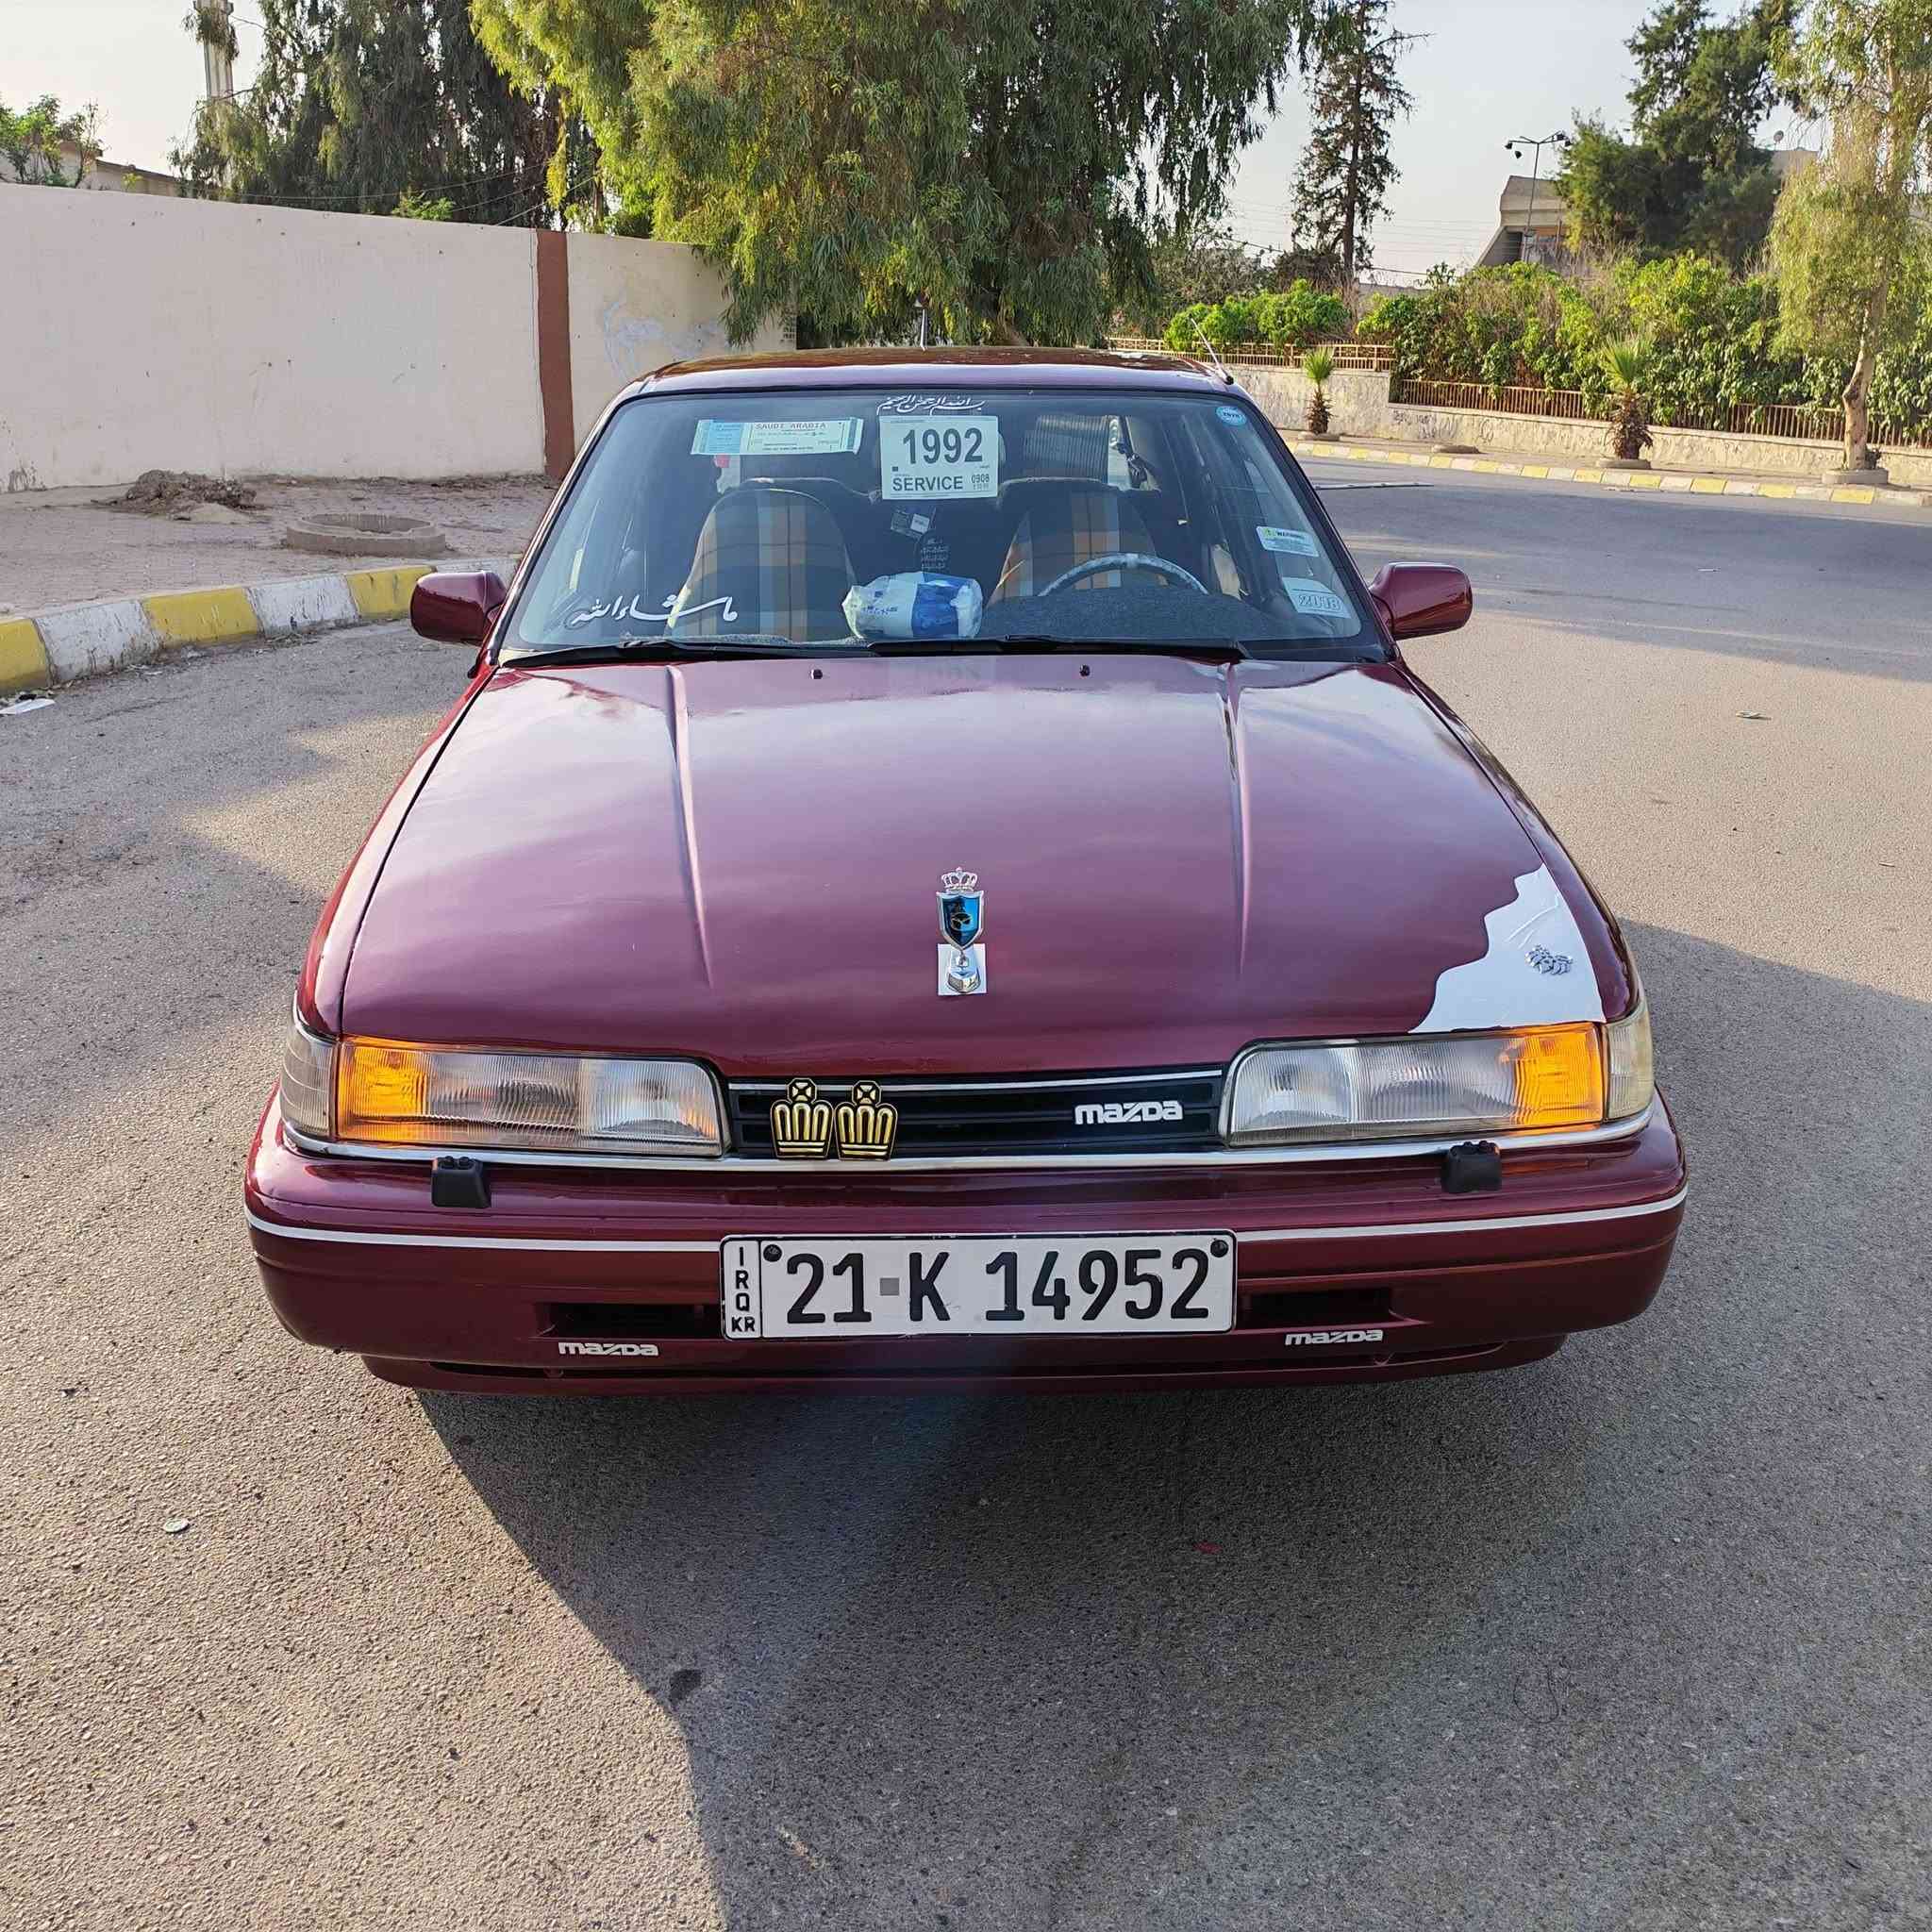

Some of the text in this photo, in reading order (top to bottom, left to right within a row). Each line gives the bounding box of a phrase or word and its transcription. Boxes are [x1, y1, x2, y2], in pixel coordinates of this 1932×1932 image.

[903, 427, 983, 465] 1992
[892, 475, 963, 491] SERVICE
[787, 1248, 1210, 1324] 21 K 14952
[731, 1316, 756, 1332] KR
